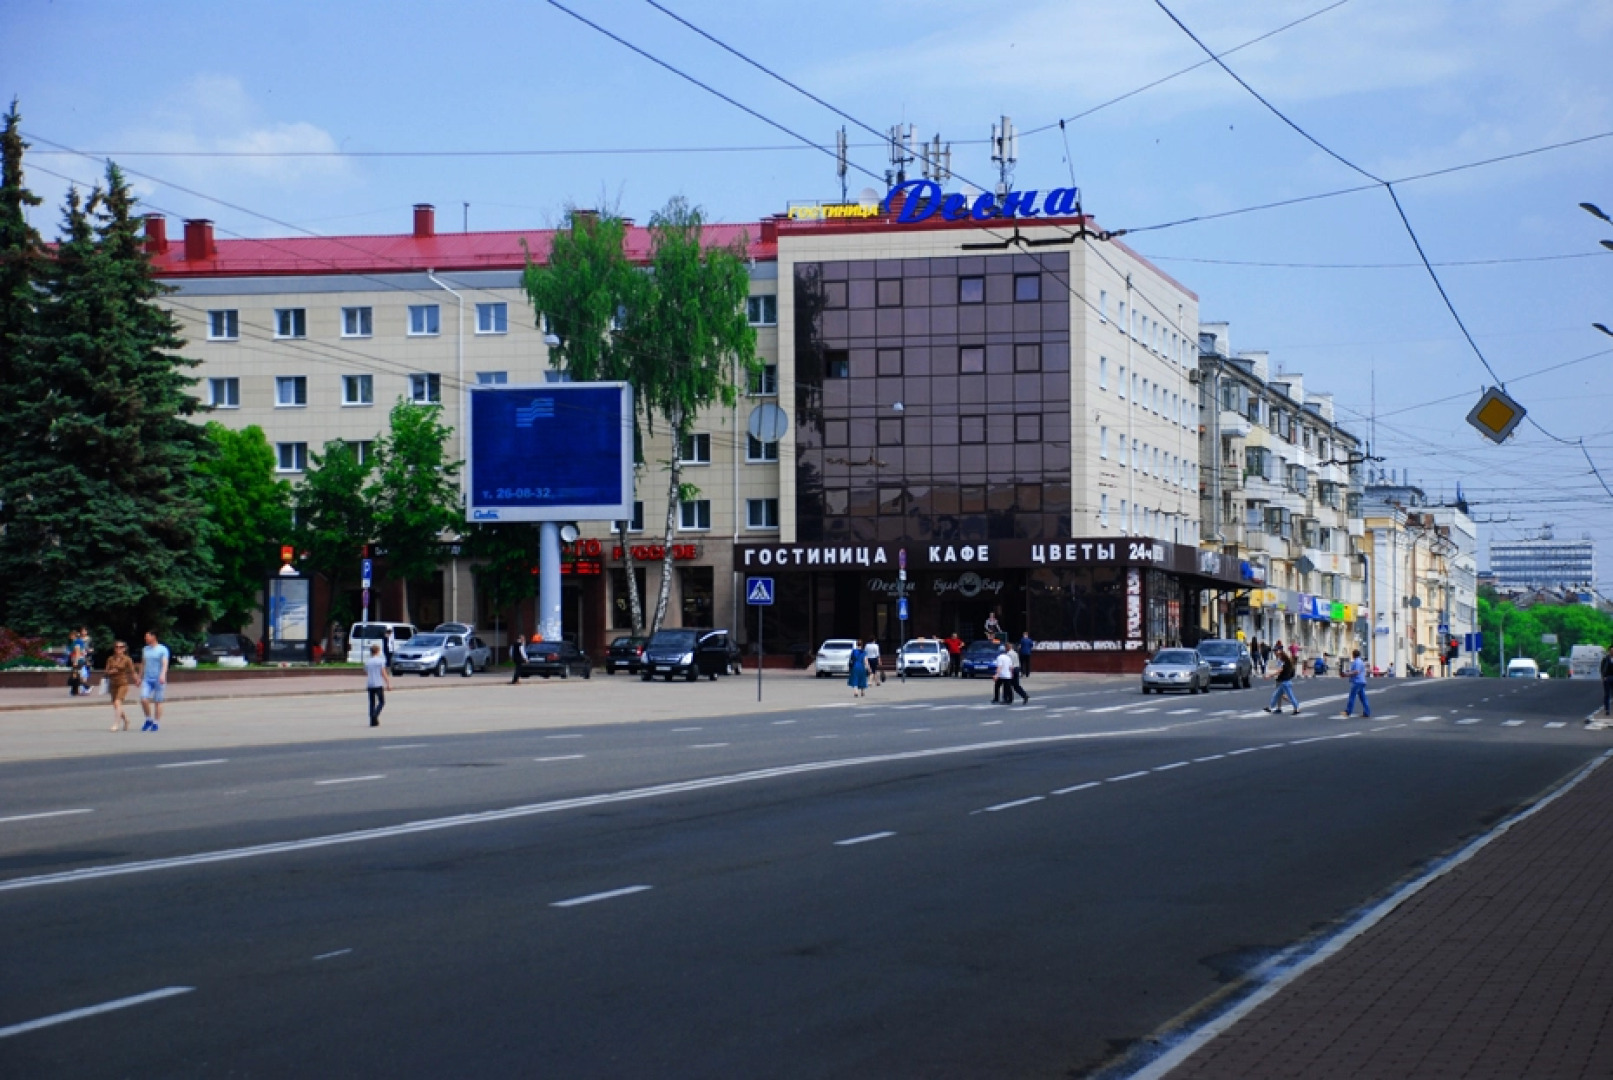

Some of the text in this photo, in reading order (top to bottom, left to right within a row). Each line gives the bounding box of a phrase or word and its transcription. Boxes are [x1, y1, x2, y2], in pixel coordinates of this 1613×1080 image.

[884, 179, 1078, 223] Десна
[744, 547, 887, 566] ГОСТИНИЦА
[929, 543, 989, 562] КАФЕ
[1032, 543, 1115, 563] ЦВЕТЫ
[868, 577, 915, 591] Деса
